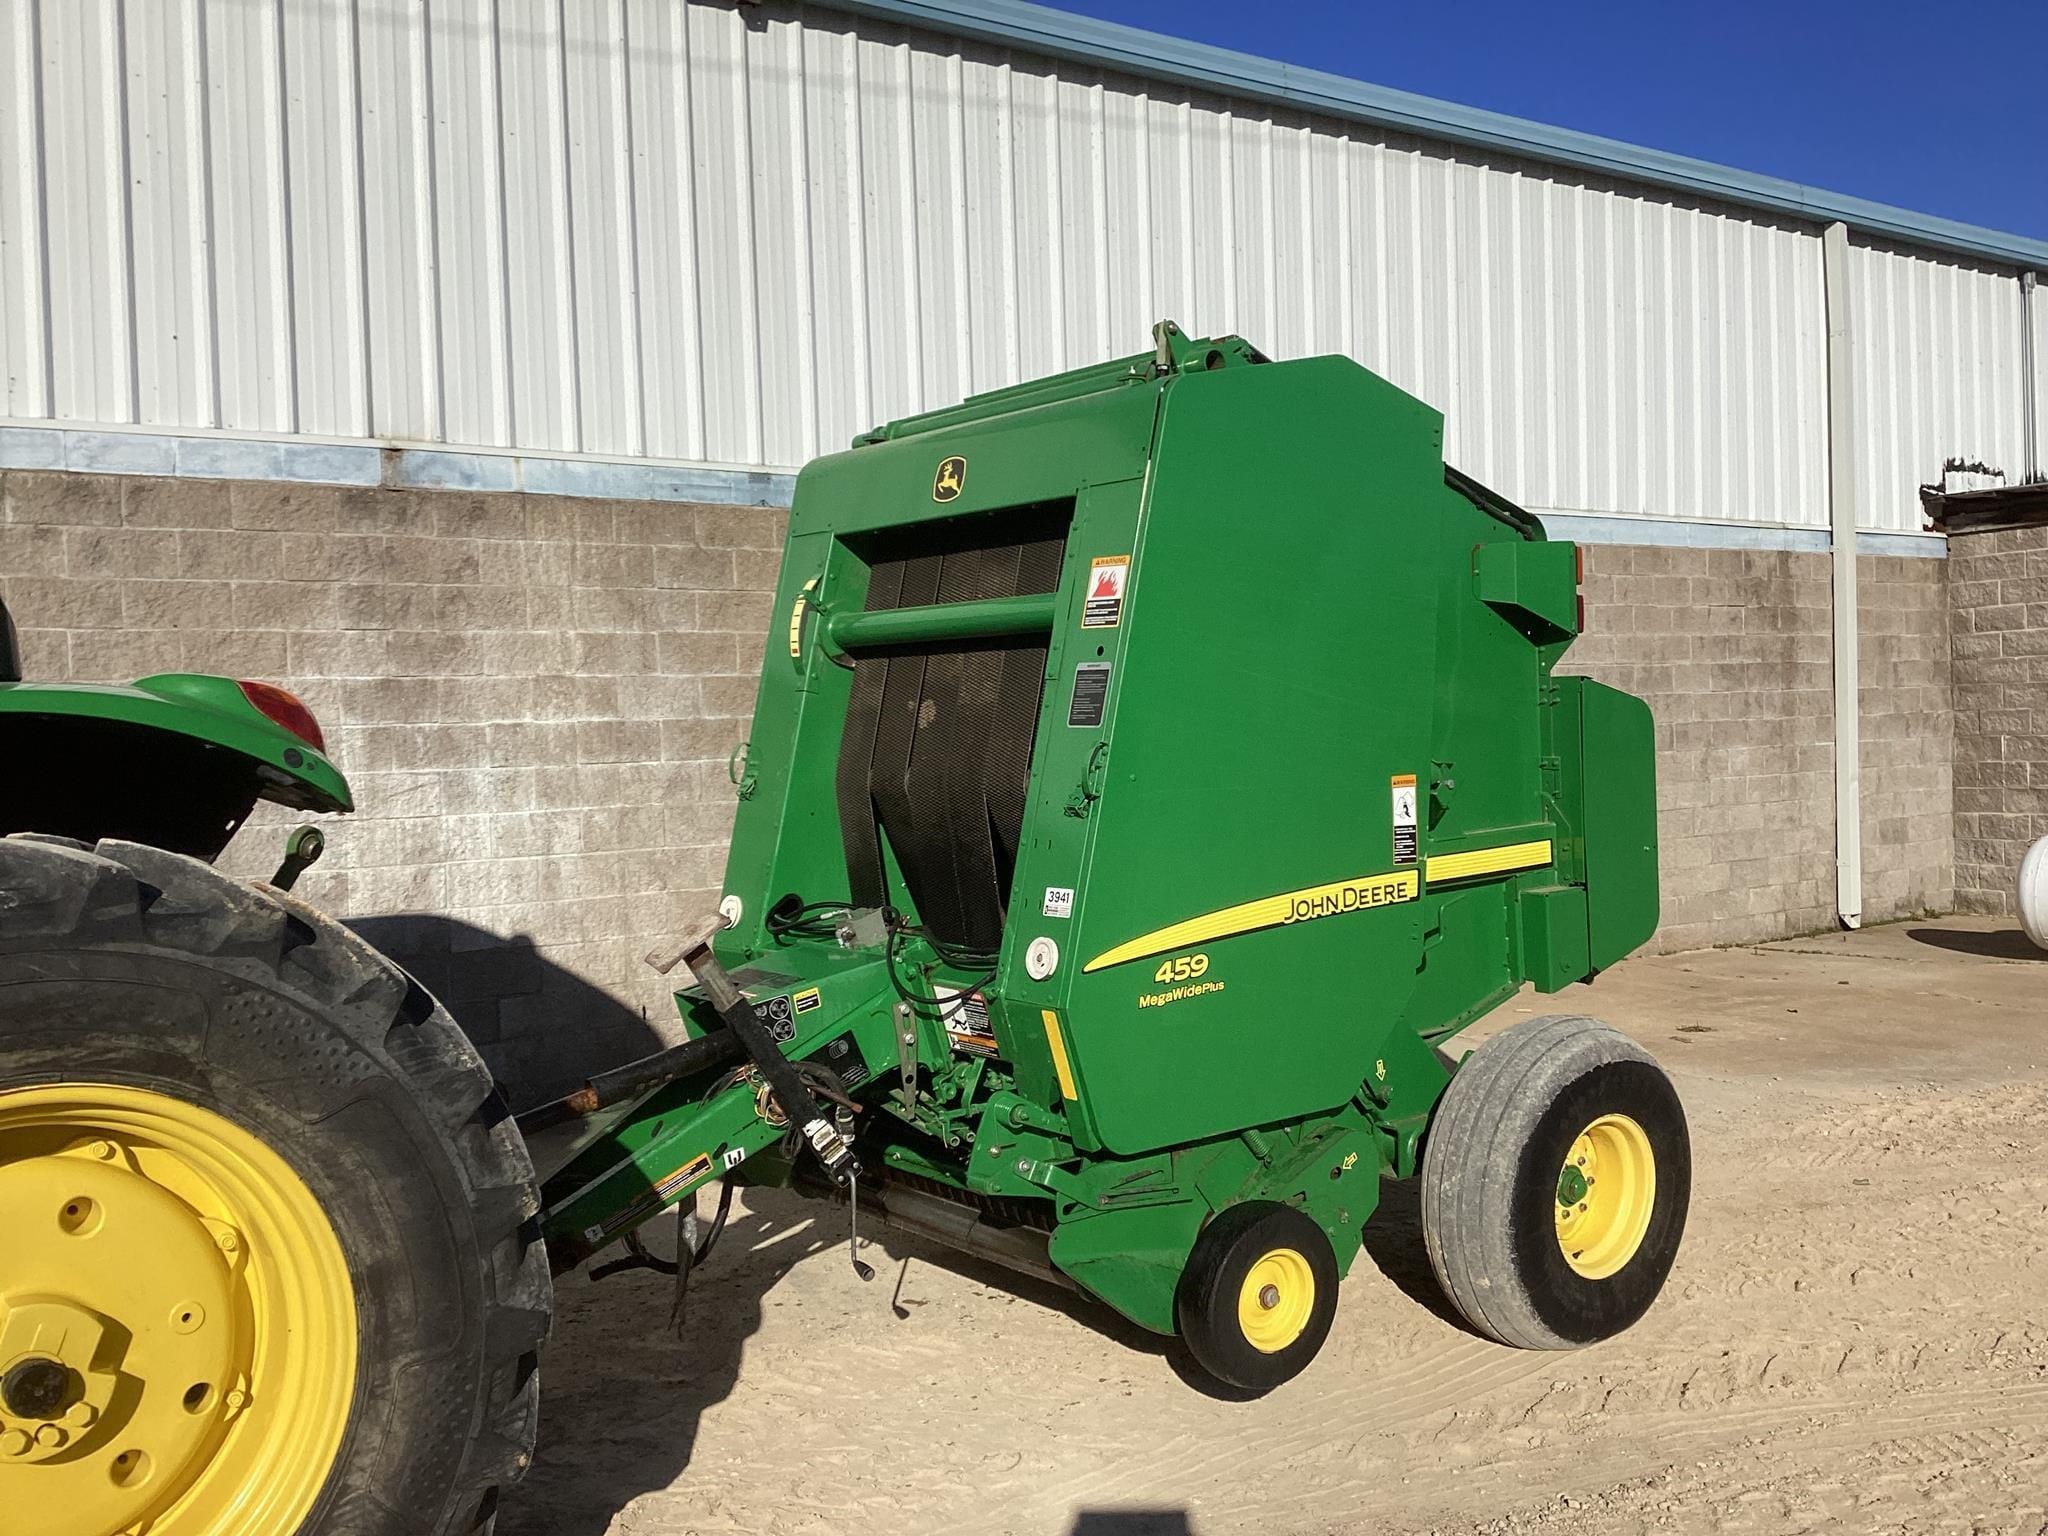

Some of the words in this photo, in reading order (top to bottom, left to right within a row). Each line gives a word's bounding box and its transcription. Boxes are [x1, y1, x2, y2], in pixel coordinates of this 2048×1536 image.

[1048, 890, 1070, 904] 3941
[1284, 893, 1339, 921] JOHN
[1343, 882, 1408, 909] DEERE
[1154, 953, 1209, 984] 459
[1138, 981, 1225, 1008] MegaWidePlus
